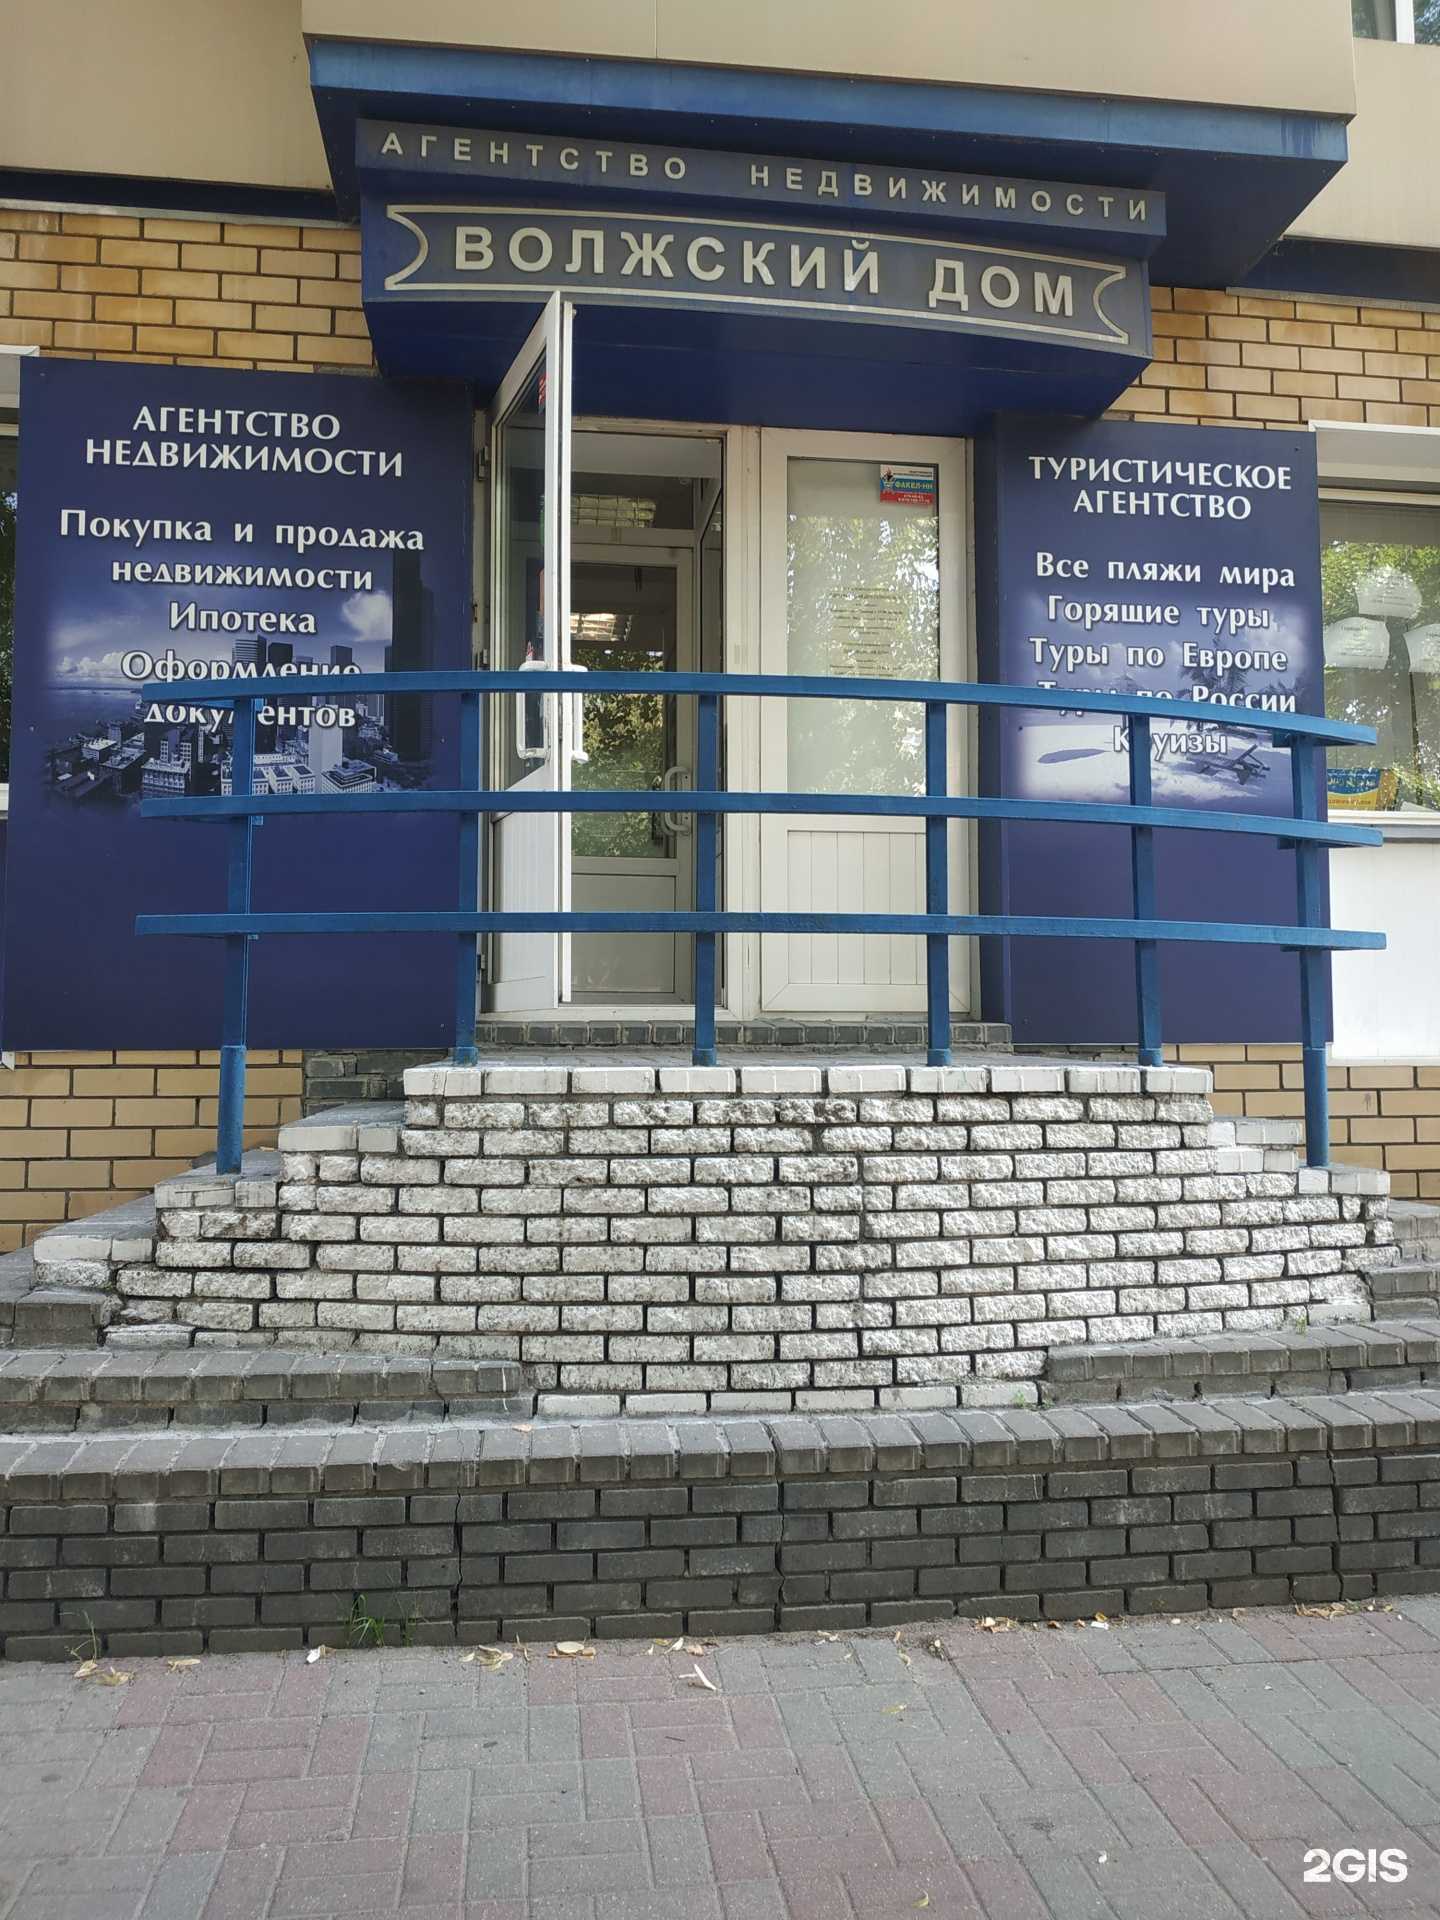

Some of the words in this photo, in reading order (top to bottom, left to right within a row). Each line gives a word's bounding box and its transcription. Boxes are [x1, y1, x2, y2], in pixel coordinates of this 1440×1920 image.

[381, 132, 687, 180] АГЕНТСТВО
[750, 164, 1148, 221] НЕДВИЖИМОСТИ
[455, 225, 879, 294] ВОЛЖСКИЙ
[928, 258, 1074, 317] ДОМ
[133, 405, 340, 440] АГЕНТСТВО
[86, 438, 403, 477] НЕДВИЖИМОСТИ
[1029, 456, 1292, 490] ТУРИСТИЧЕСКОЕ
[1073, 490, 1252, 520] АГЕНТСТВО
[60, 509, 212, 547] Покупка
[234, 523, 254, 543] и
[275, 523, 425, 553] продажа
[112, 561, 373, 590] недвижимости
[1036, 552, 1089, 578] Все
[1108, 561, 1201, 583] пляжи
[1219, 567, 1296, 593] мира
[170, 602, 316, 633] Ипотека
[1198, 606, 1269, 634] туры
[1029, 637, 1109, 672] Туры
[1127, 647, 1165, 667] по
[1183, 642, 1287, 676] Европе
[1193, 685, 1296, 713] России
[144, 702, 356, 733] докуентов
[1113, 726, 1228, 761] Куизы
